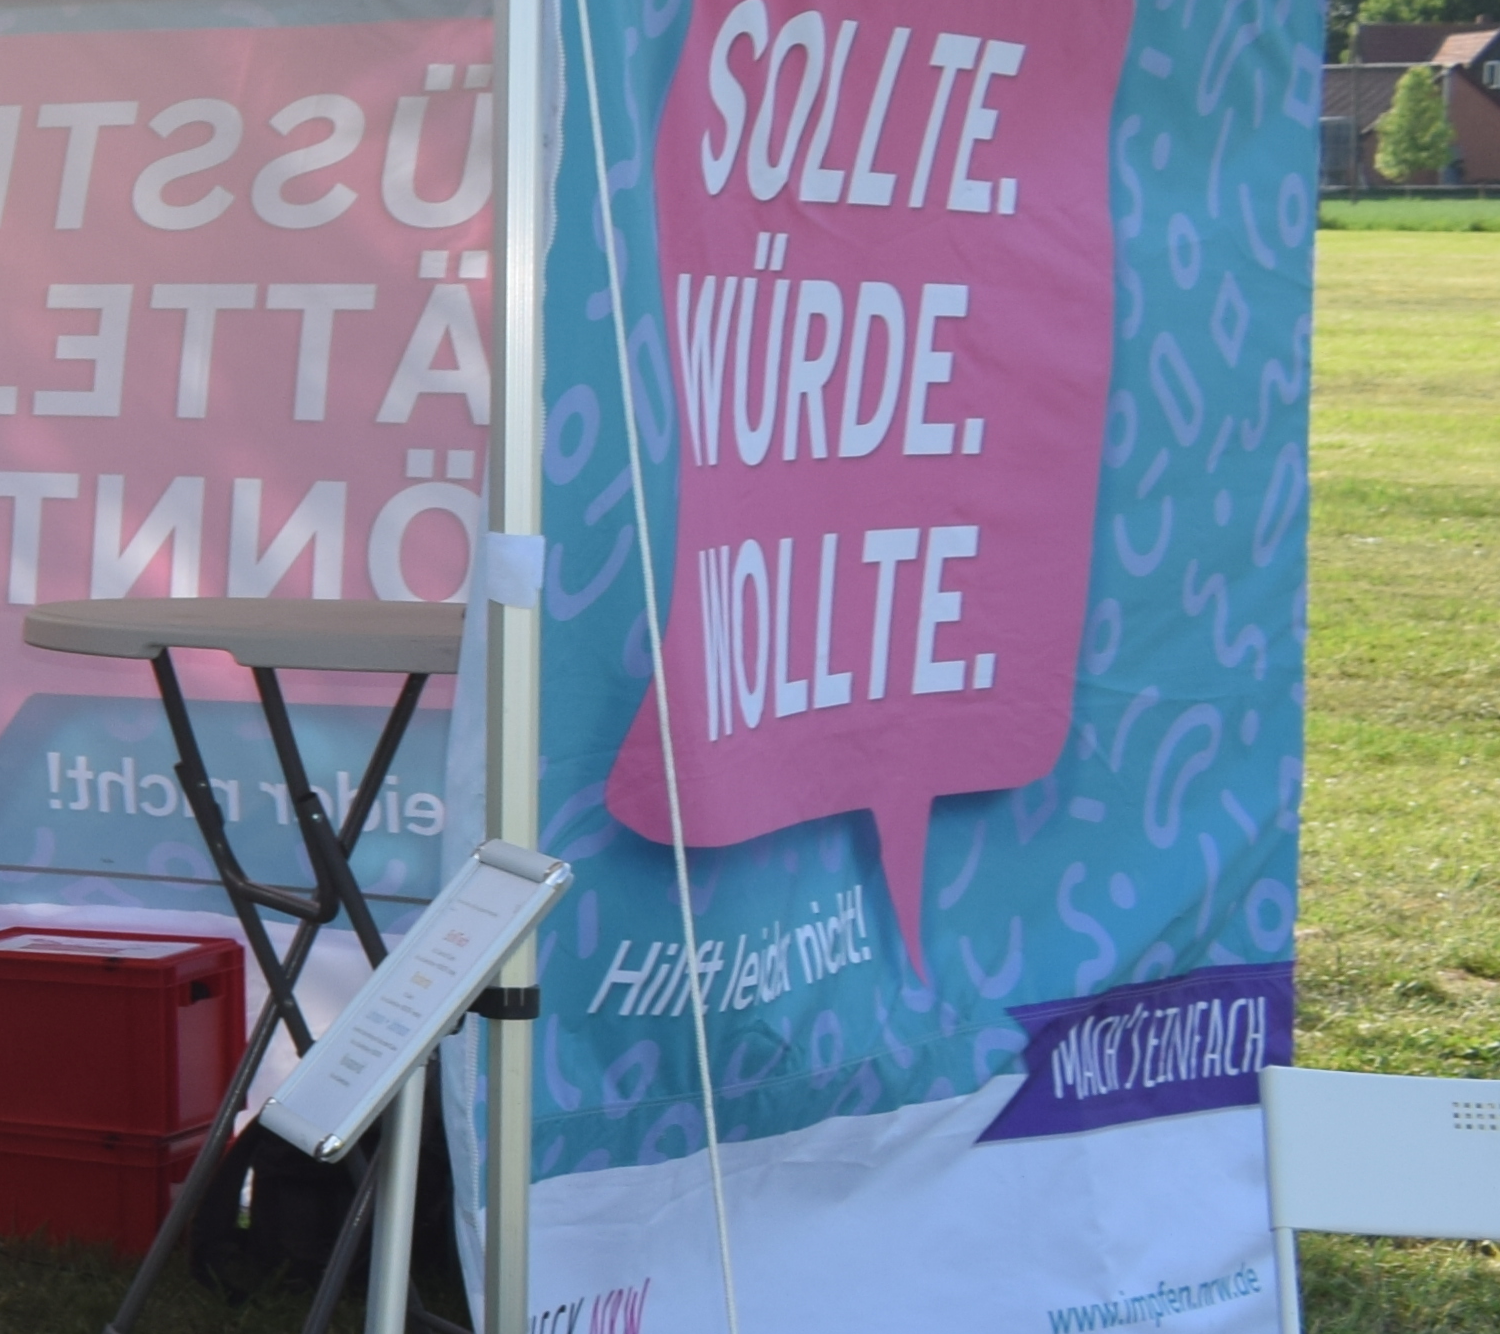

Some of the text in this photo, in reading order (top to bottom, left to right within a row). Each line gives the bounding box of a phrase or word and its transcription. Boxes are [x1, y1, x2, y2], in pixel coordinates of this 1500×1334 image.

[676, 232, 985, 467] WÜRDE.
[699, 524, 996, 742] WOLLTE.
[587, 939, 725, 1017] Hilft
